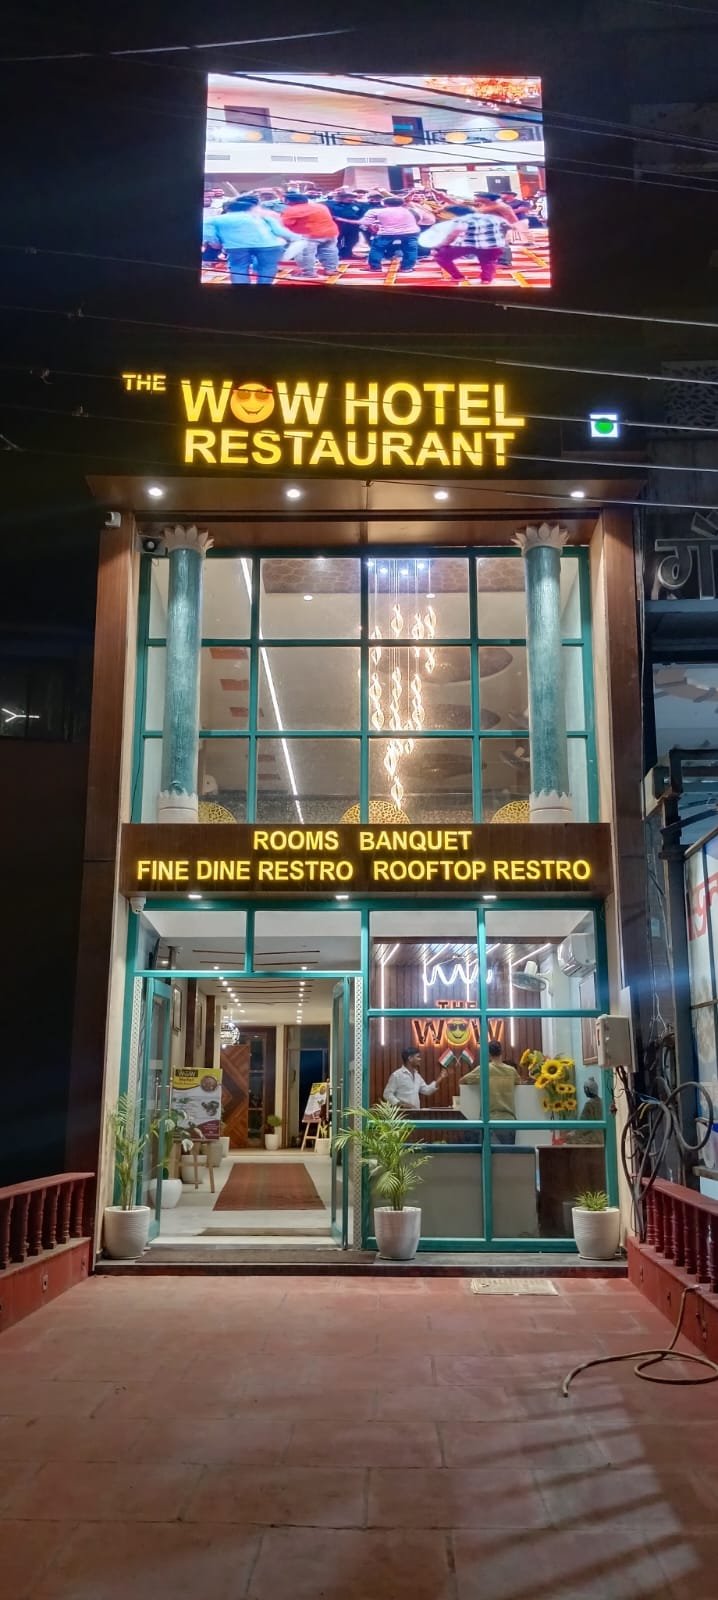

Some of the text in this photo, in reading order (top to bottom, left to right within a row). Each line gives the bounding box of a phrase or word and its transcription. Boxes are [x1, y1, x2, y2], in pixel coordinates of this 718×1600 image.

[122, 373, 525, 426] THE WOW HOTEL
[185, 428, 515, 466] RESTAURANT
[253, 831, 472, 852] ROOMS BANQUET
[137, 860, 591, 881] FINE DINE RESTRO ROOFTOP RESTRO
